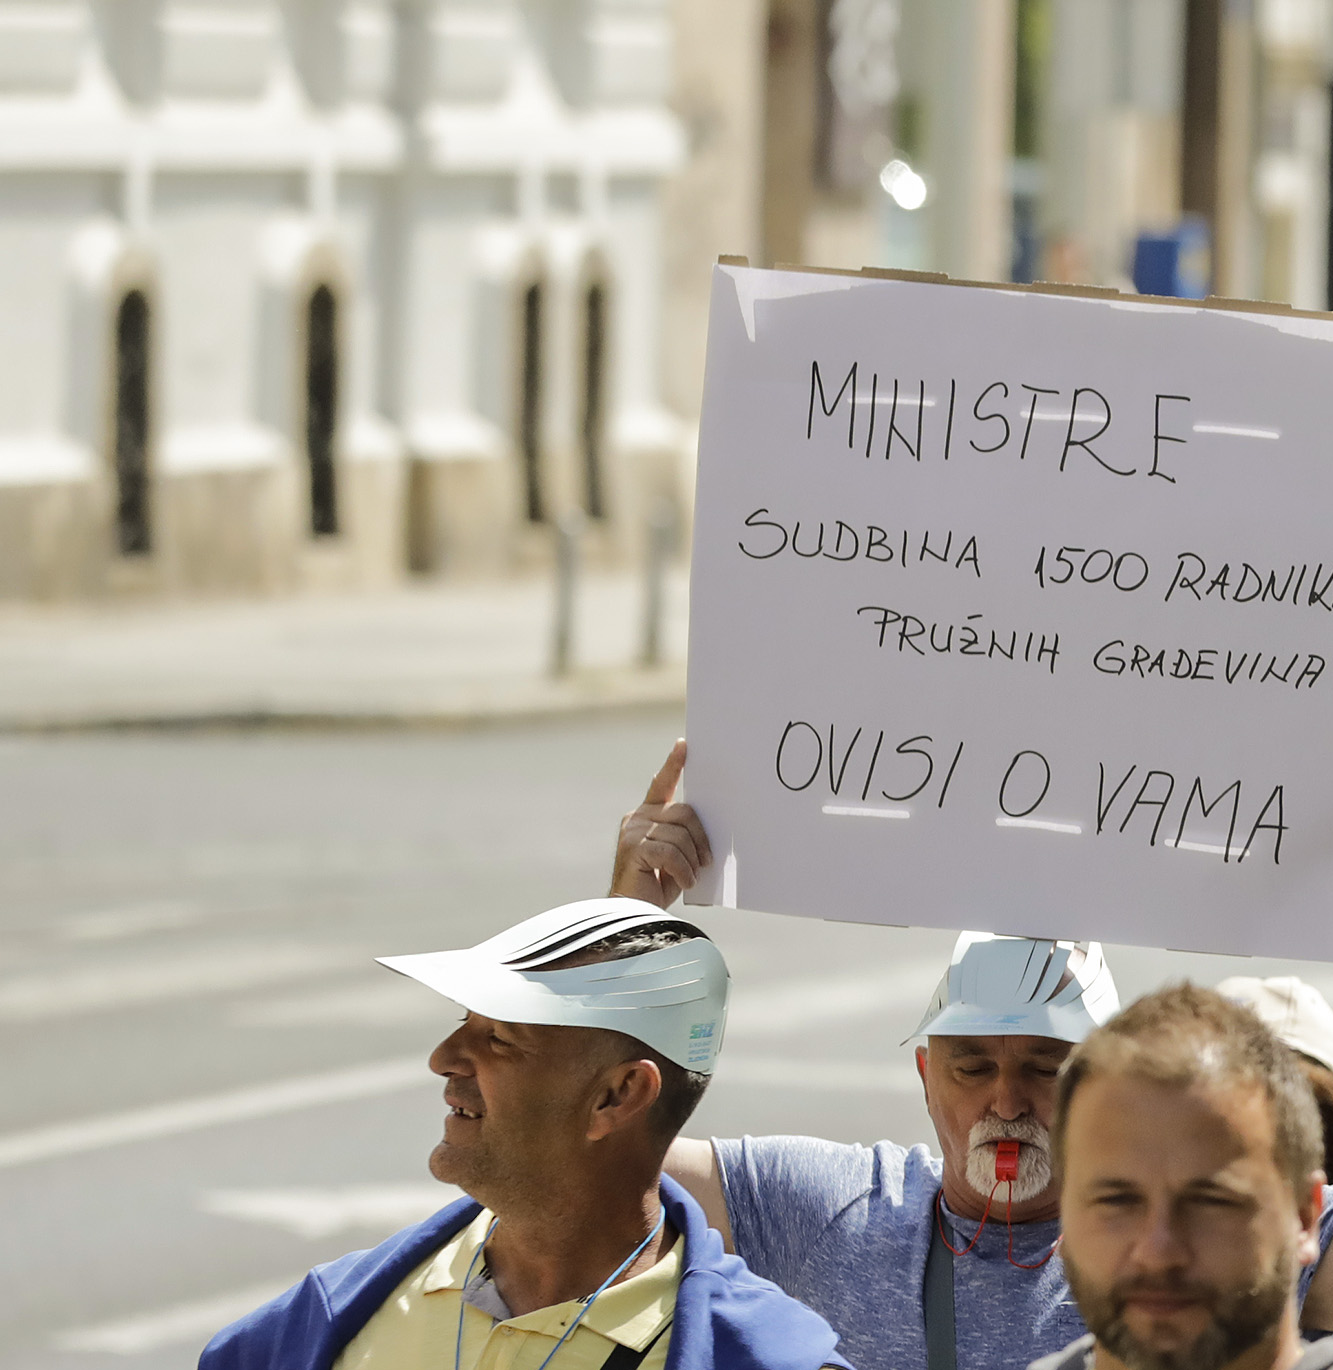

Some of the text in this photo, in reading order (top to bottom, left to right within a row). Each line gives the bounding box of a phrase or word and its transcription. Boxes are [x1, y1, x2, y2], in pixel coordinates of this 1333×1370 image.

[806, 360, 1191, 484] MINISTRE
[738, 508, 981, 578] SUDBINA
[1034, 546, 1149, 592] 1500
[775, 720, 1291, 866] OVISI O VAMA
